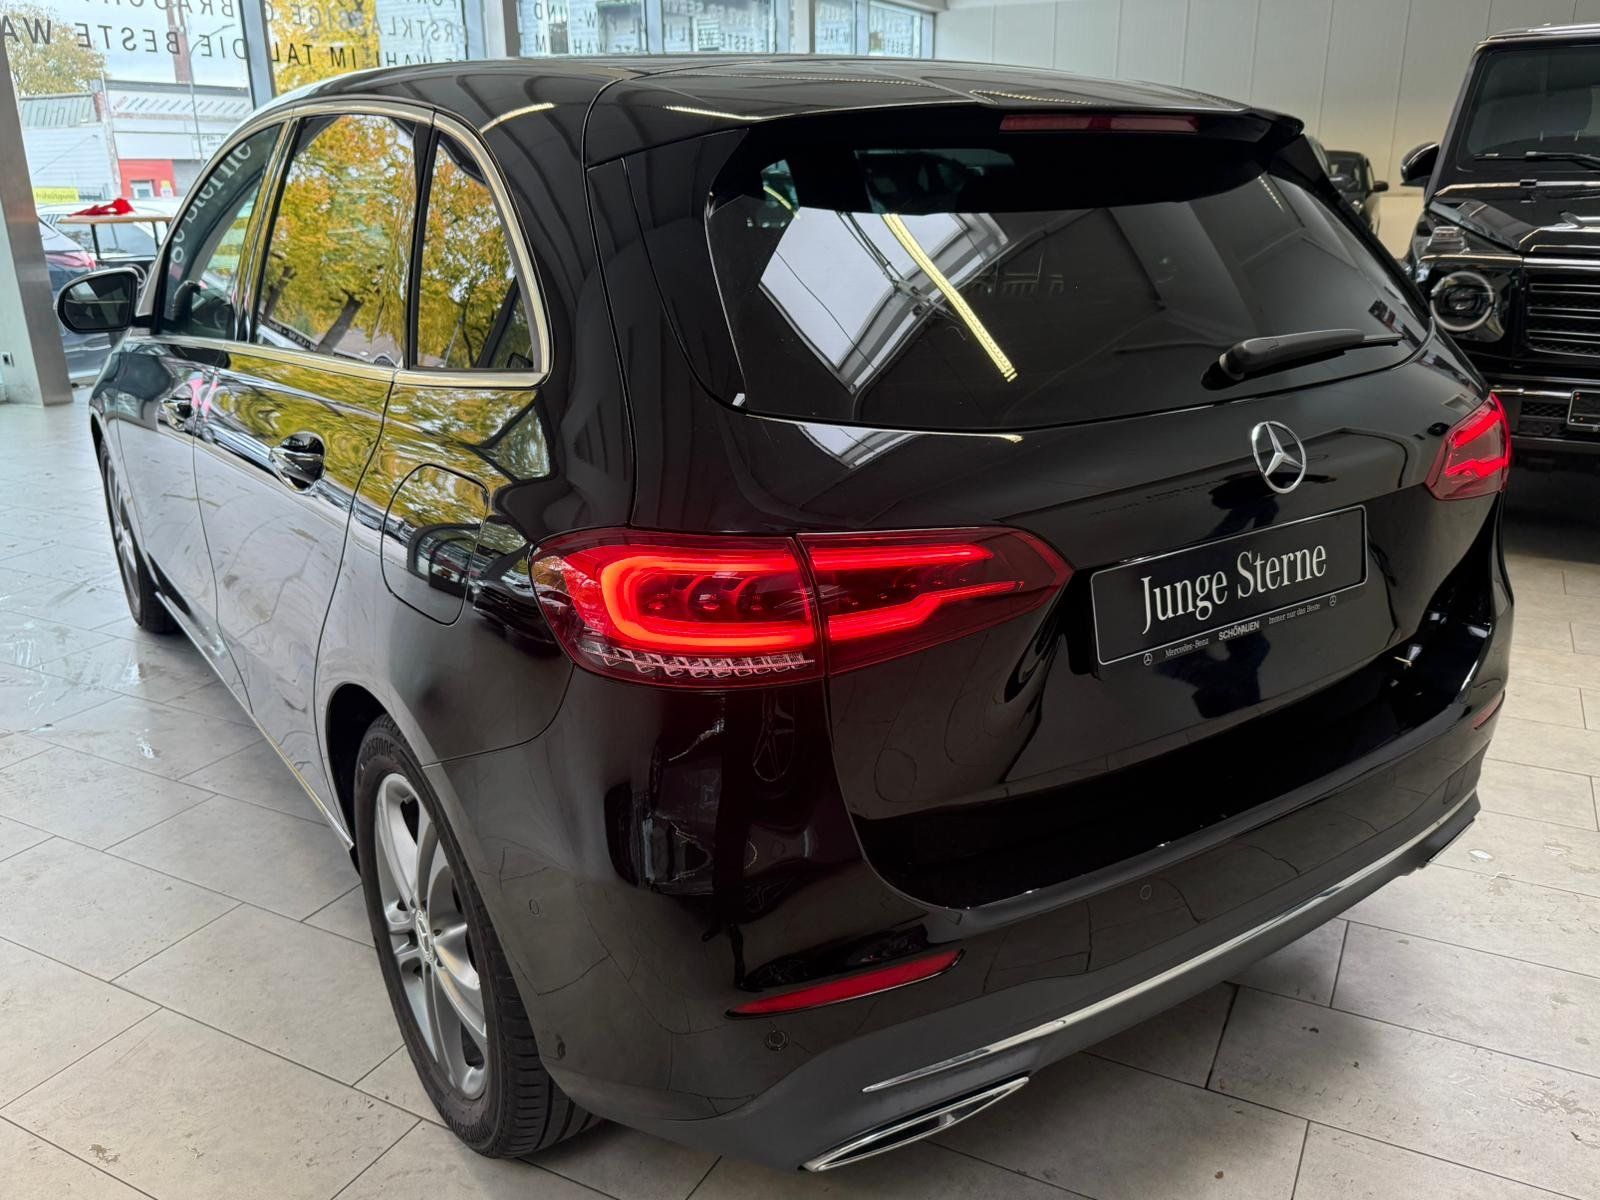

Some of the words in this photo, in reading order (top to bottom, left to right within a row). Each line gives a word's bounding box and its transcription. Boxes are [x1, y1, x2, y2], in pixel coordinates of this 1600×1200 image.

[1140, 570, 1228, 635] Junge
[1236, 545, 1327, 600] Sterne
[1165, 638, 1209, 658] Mercedes-Benz
